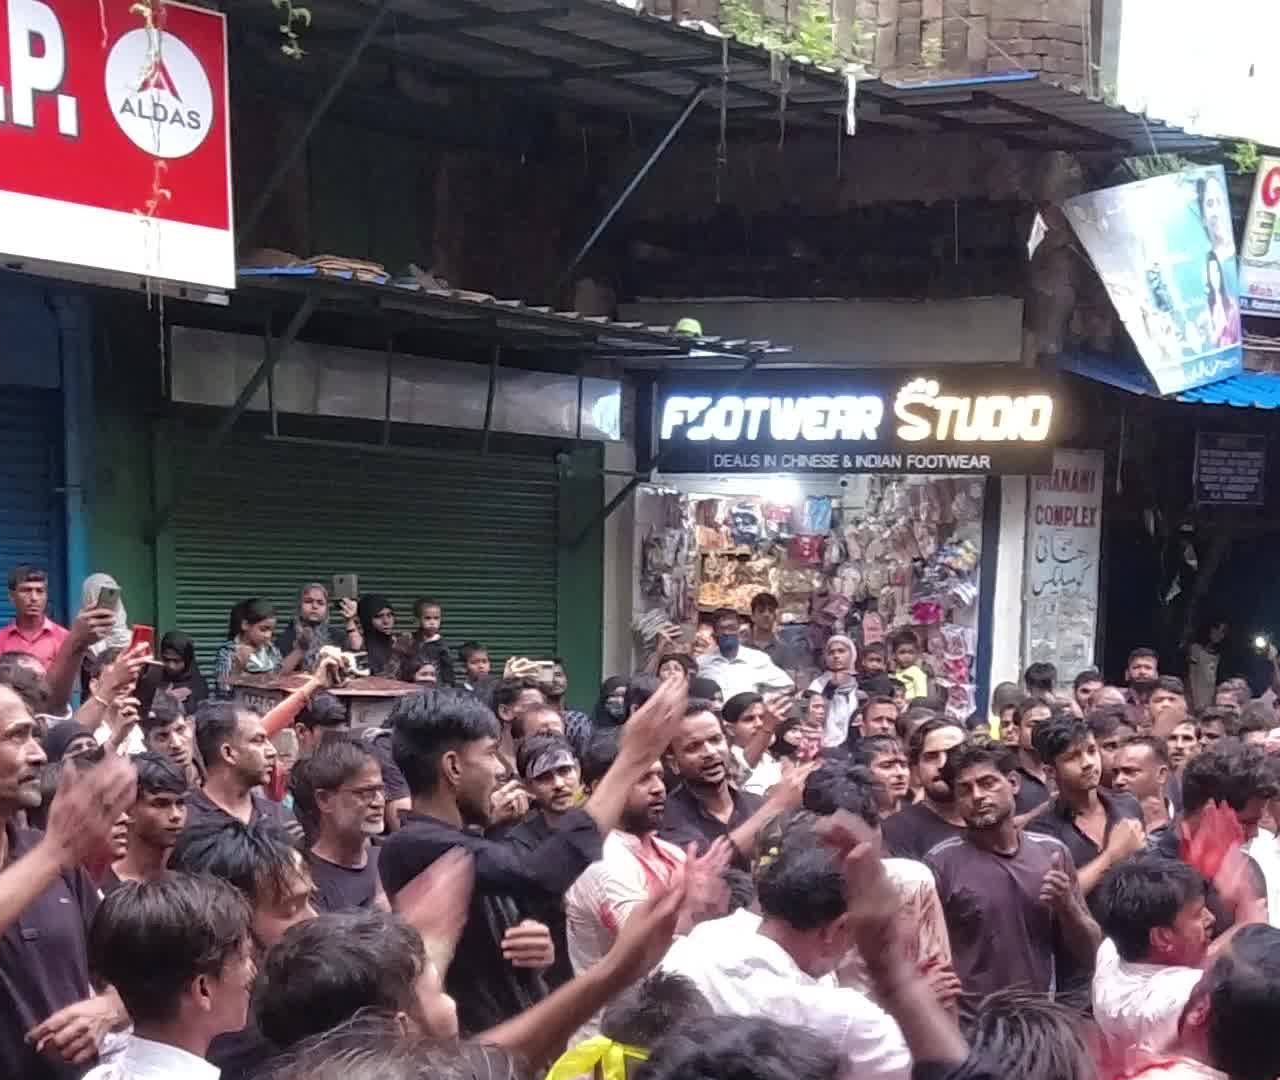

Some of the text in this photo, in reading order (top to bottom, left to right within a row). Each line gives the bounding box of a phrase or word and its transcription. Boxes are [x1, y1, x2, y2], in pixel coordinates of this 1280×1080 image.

[119, 96, 202, 131] ALDAS
[660, 378, 1054, 442] FOOTWEAR STUDIO
[714, 454, 991, 469] DEALS IN CHINESE & INDIAN FOOTWEAR
[1034, 503, 1097, 528] COMPLEX
